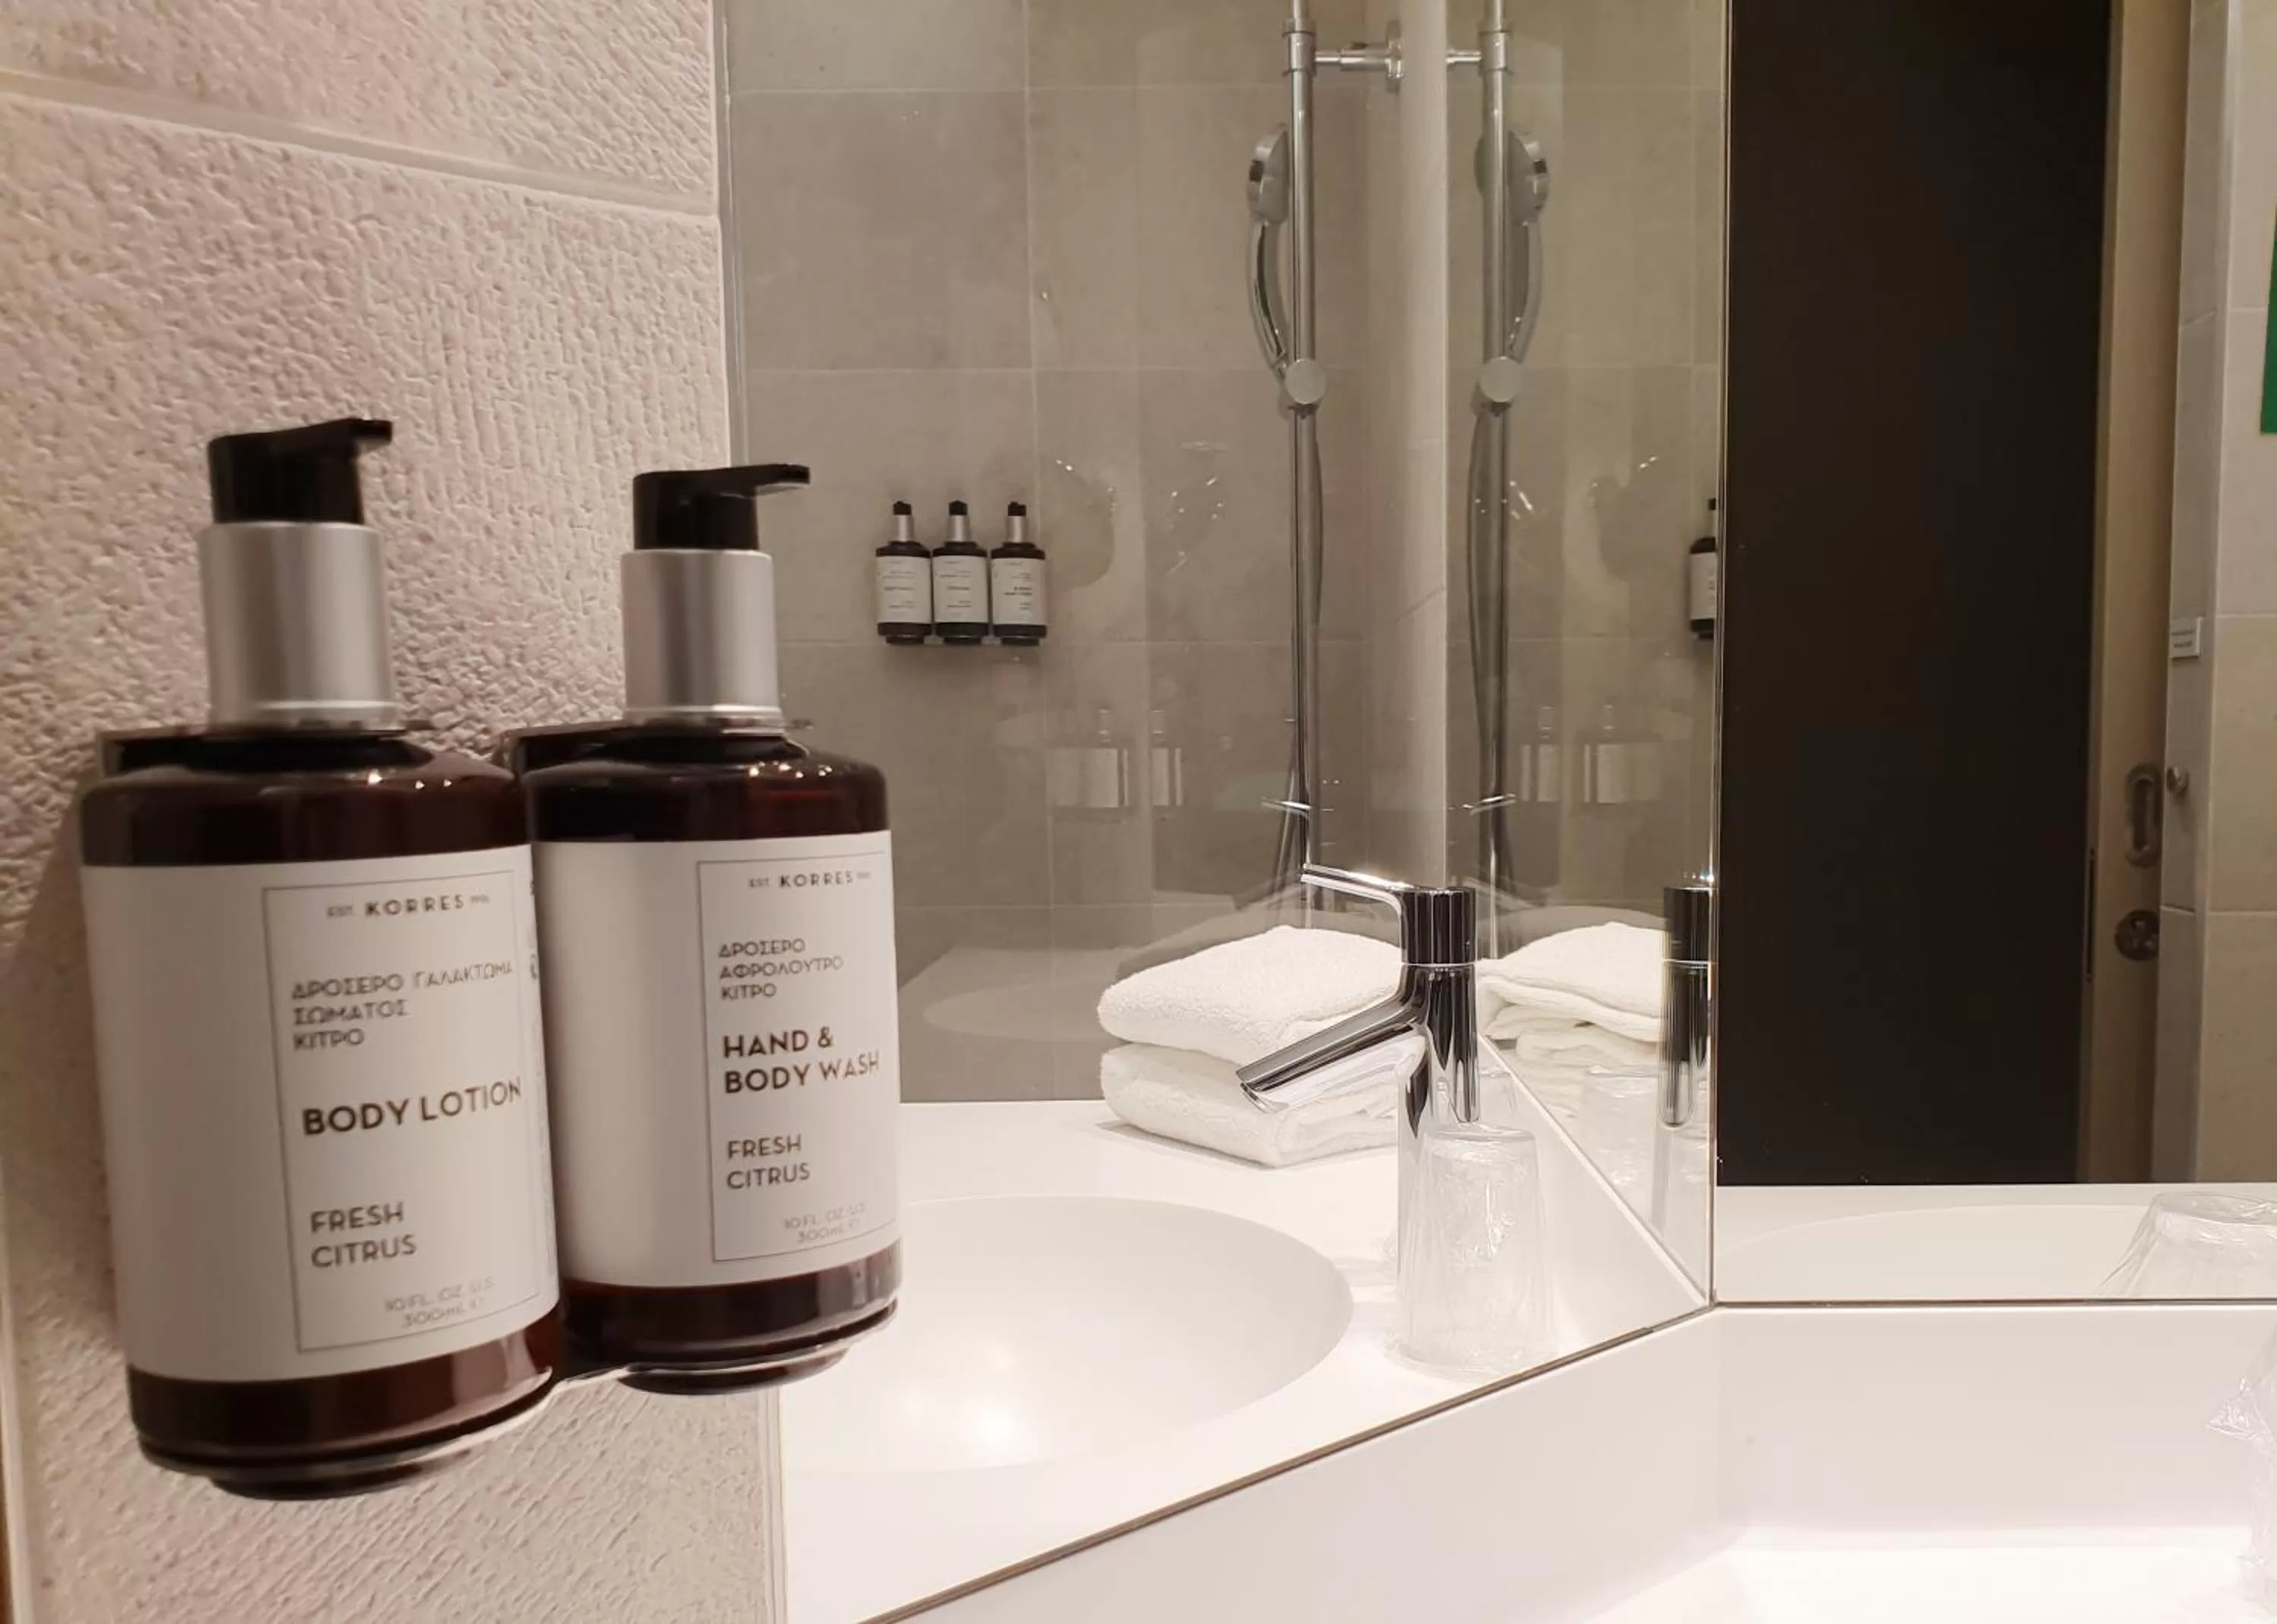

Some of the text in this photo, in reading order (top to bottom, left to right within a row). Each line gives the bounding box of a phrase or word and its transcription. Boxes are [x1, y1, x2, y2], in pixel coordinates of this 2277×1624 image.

[779, 871, 853, 888] KORRES
[365, 894, 465, 917] KORRES
[719, 938, 806, 958] ΔΡΟΣΕΡΟ
[292, 973, 405, 999] ΔΡΟΣΕΡΟ
[721, 983, 777, 1000] ΚΙΤΡΟ
[293, 1028, 365, 1051] ΚΙΤΡΟ
[723, 1026, 833, 1058] HAND &
[725, 1050, 880, 1094] BODY WASH
[302, 1076, 522, 1135] BODY LOTION
[727, 1134, 802, 1160] FRESH
[726, 1163, 811, 1189] CITRUS
[310, 1202, 404, 1233] FRESH
[310, 1234, 417, 1269] CITRUS
